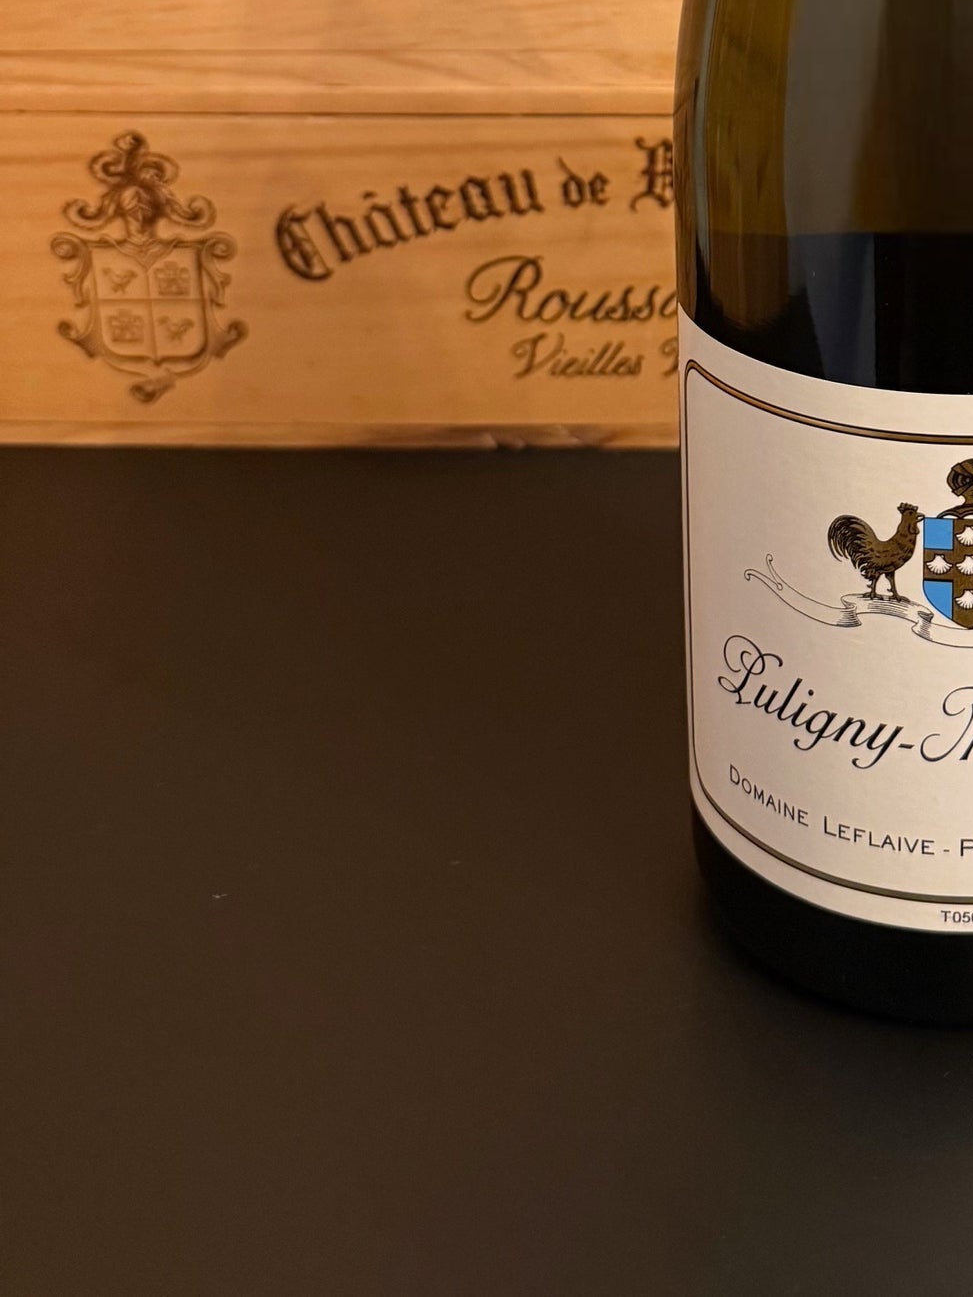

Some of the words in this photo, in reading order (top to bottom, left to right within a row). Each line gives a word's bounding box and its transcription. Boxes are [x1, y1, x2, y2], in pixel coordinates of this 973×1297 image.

[273, 168, 546, 282] Château
[557, 154, 612, 210] de
[511, 331, 645, 379] Vieilles
[728, 764, 810, 828] DOMAINE
[823, 814, 936, 857] LEFLAIVE
